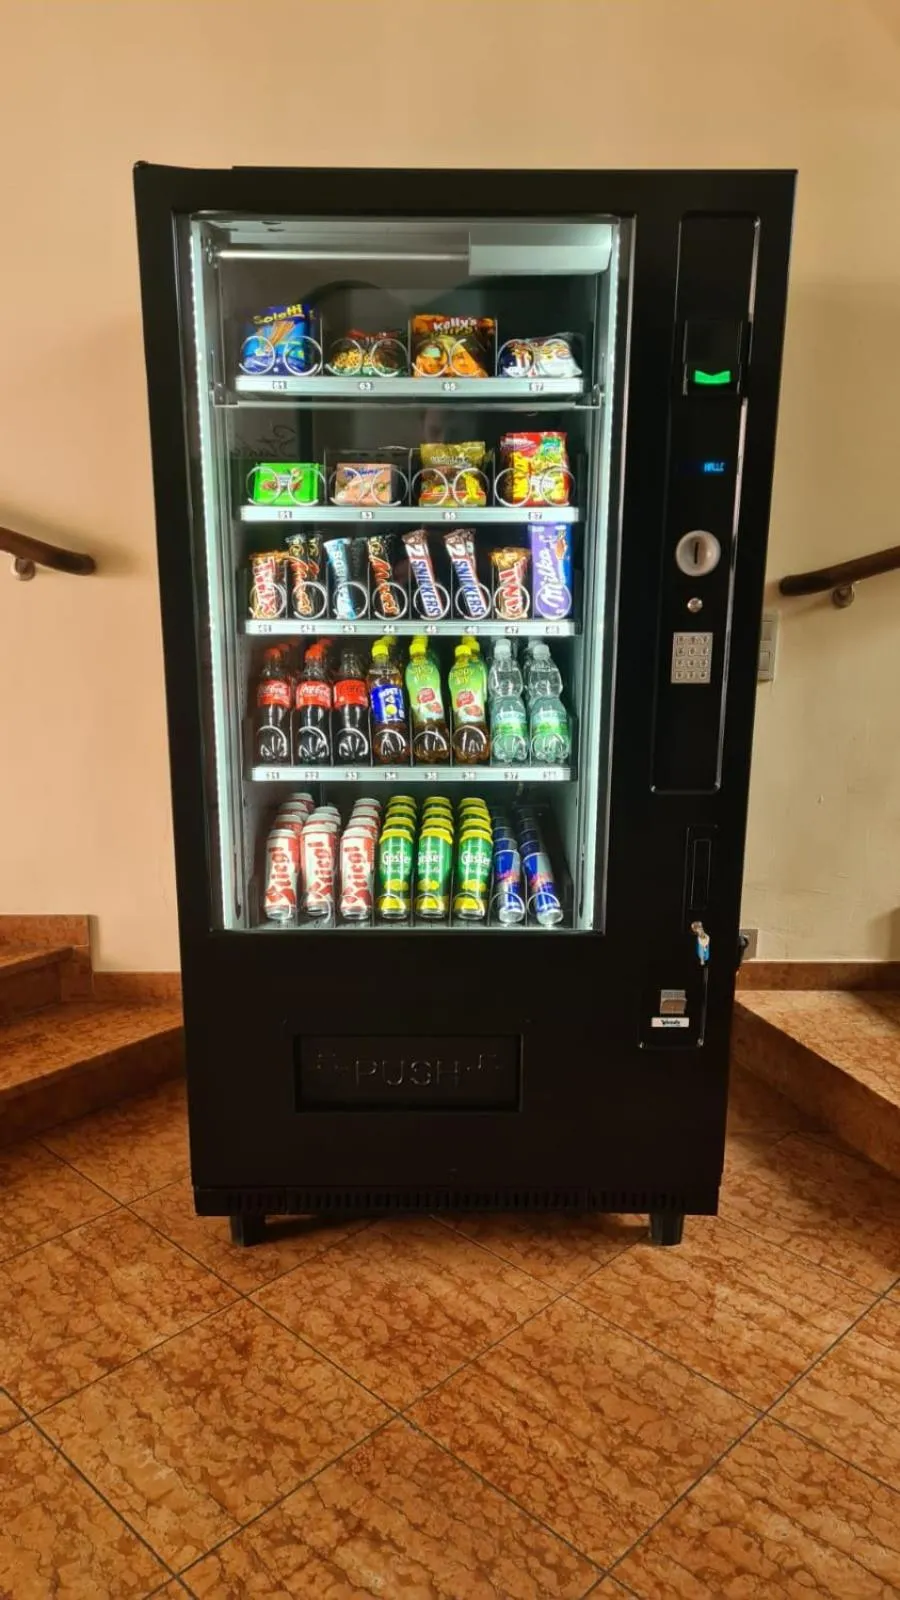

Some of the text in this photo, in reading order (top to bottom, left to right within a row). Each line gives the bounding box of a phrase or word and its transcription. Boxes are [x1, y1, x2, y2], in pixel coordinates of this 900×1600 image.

[253, 303, 303, 325] Soletti
[433, 316, 477, 331] Kelly's
[537, 548, 565, 608] Milka
[356, 1059, 459, 1086] PUSH
